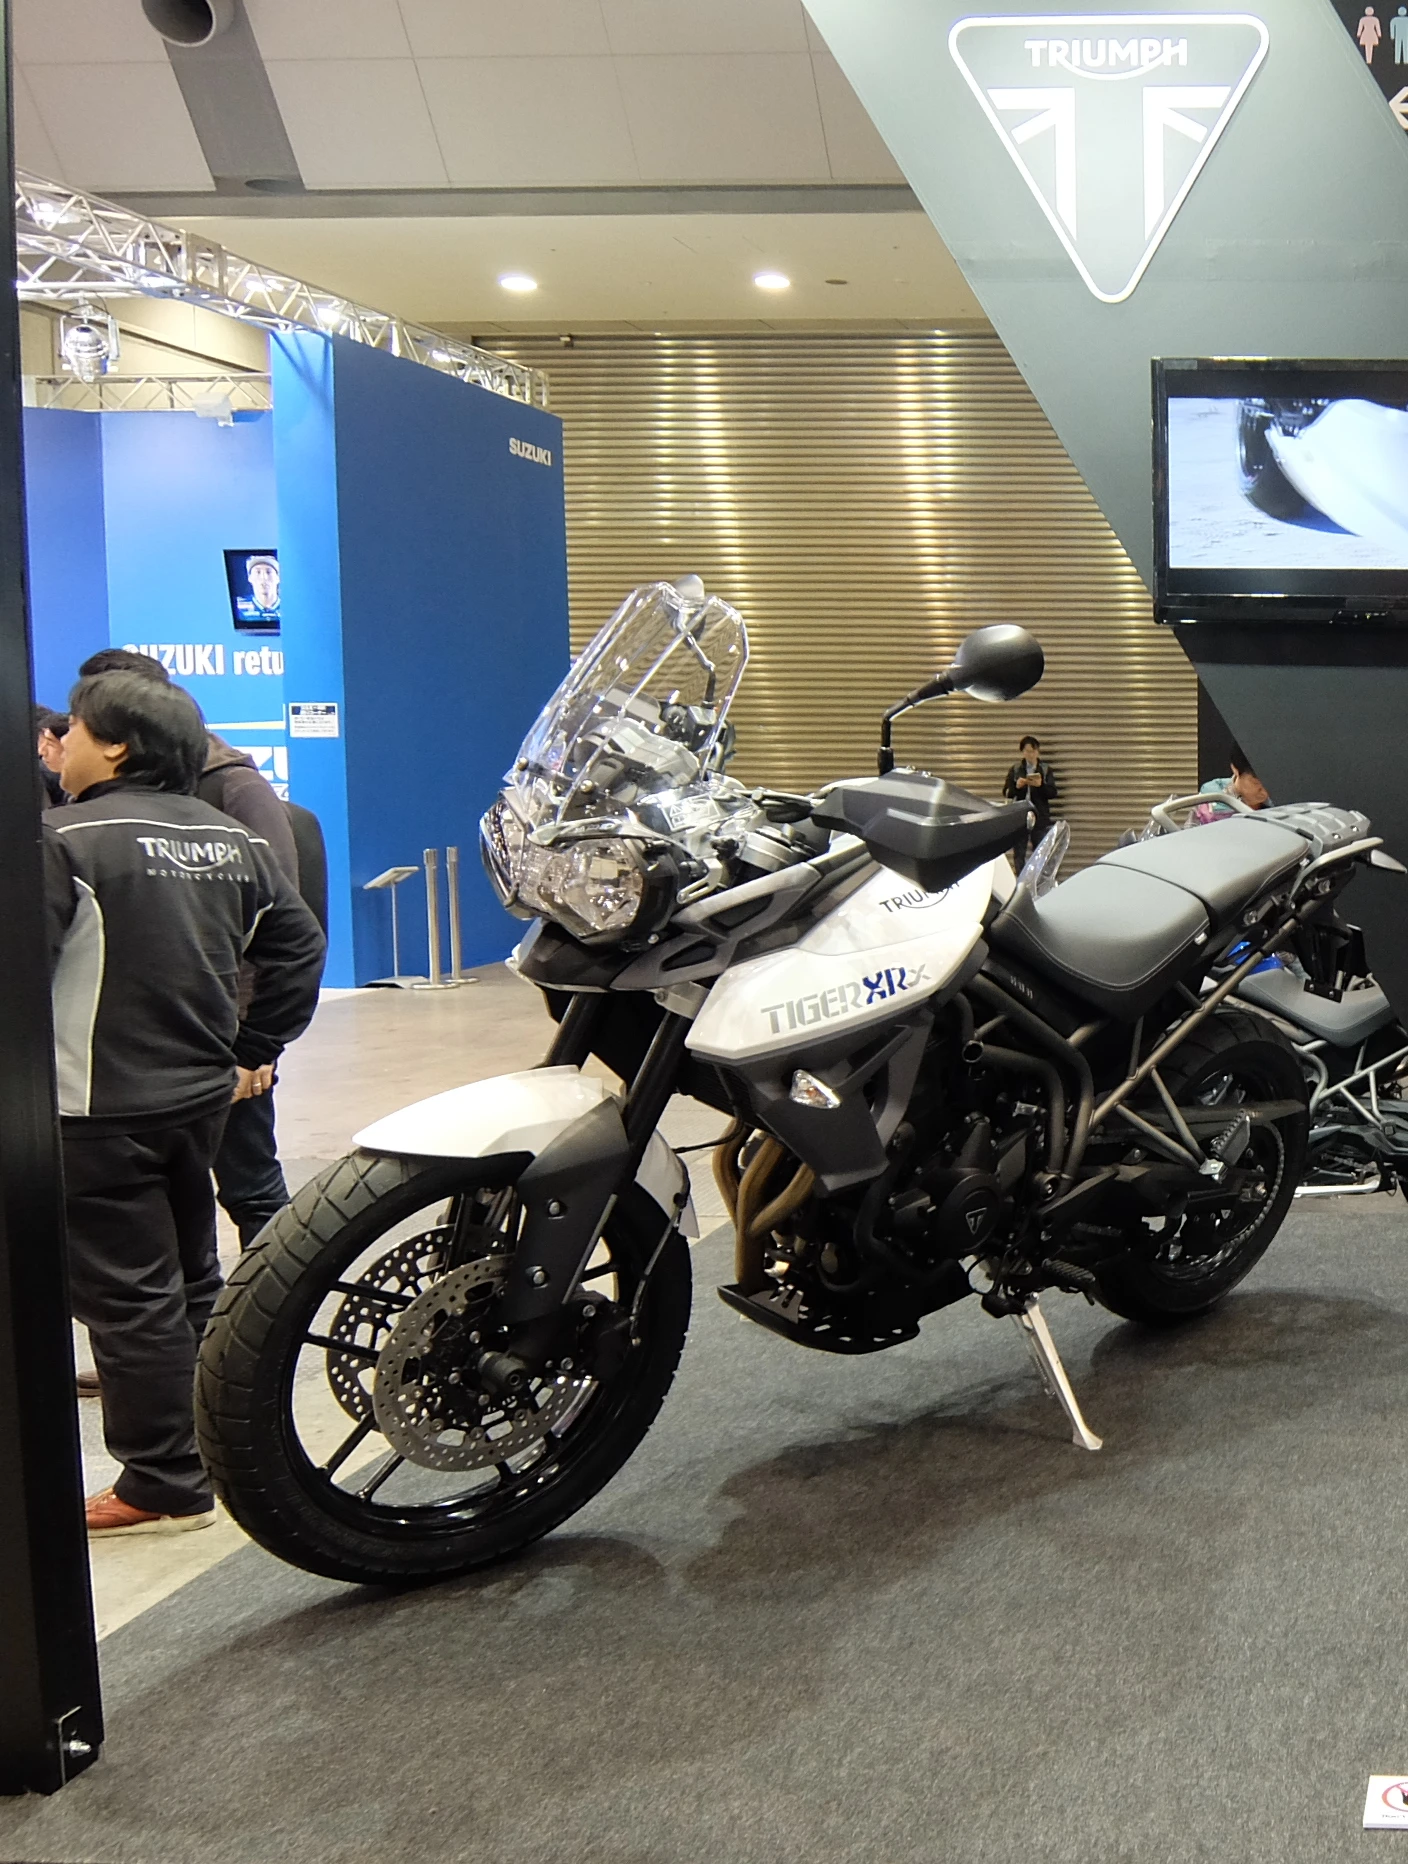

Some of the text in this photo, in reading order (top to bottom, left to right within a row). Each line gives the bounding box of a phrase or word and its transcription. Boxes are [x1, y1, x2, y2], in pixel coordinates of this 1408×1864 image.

[1024, 38, 1188, 81] TRIUMPH
[509, 437, 552, 466] SUZUKI
[122, 644, 225, 676] ZUKI
[136, 837, 243, 872] TRIUMPH
[878, 881, 960, 913] TRIU
